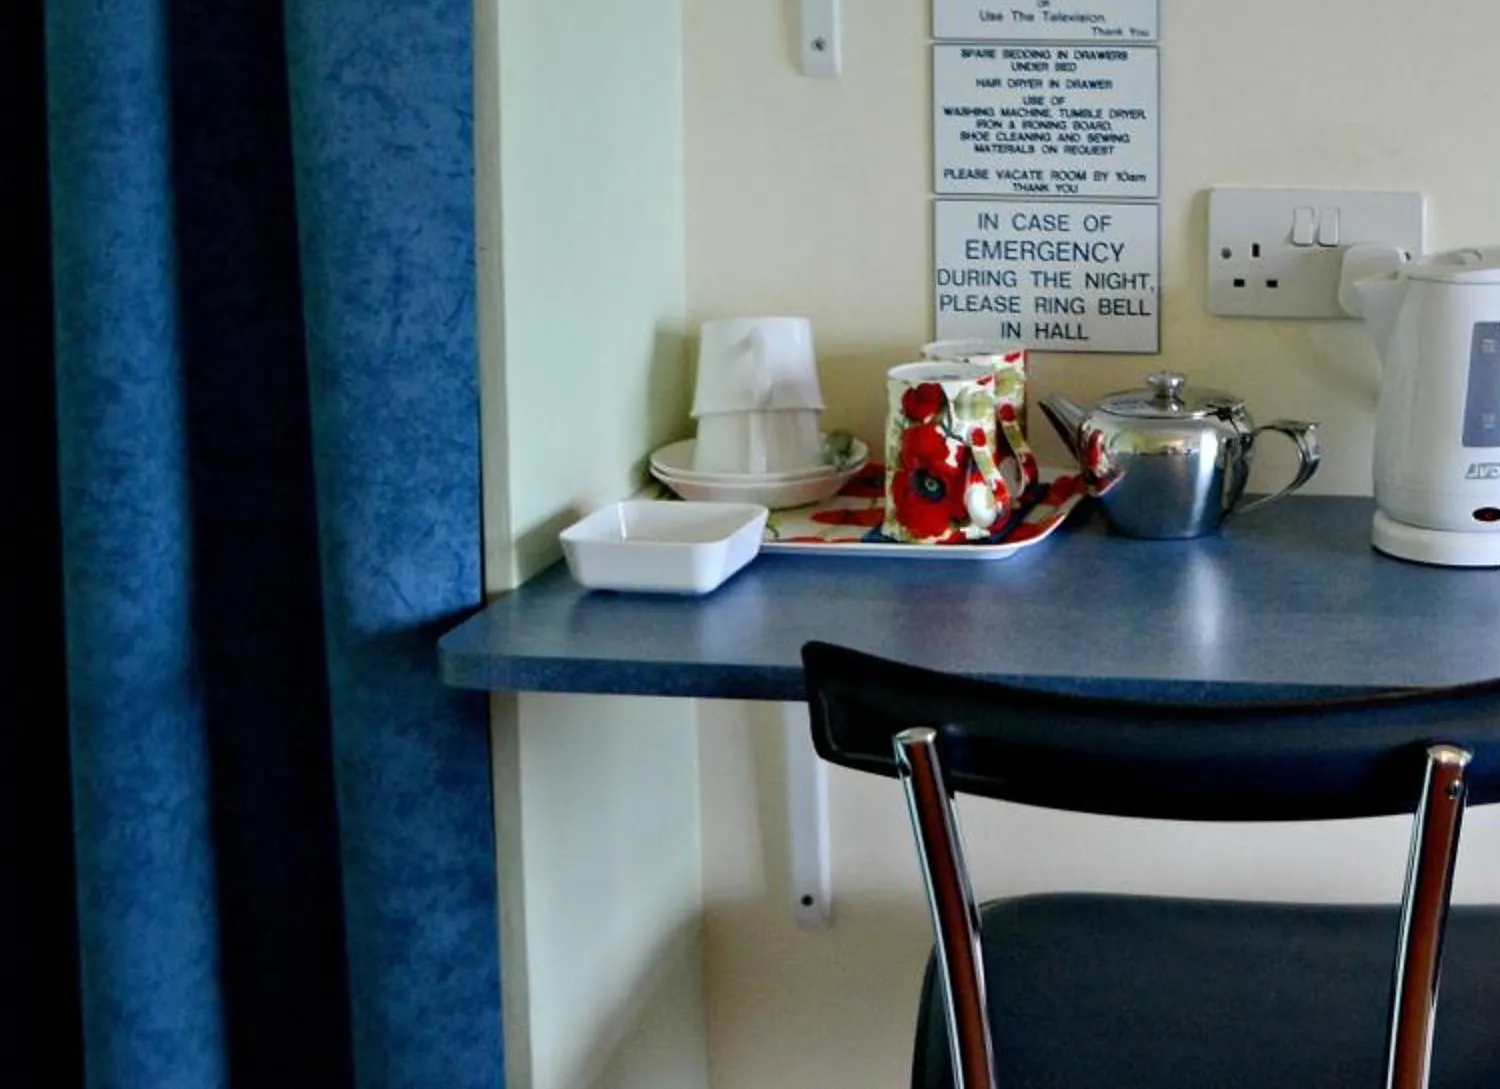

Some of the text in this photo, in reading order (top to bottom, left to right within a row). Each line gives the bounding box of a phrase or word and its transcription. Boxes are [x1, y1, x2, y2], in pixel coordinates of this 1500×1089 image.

[979, 10, 1003, 22] Use
[1011, 11, 1034, 22] The
[1092, 27, 1150, 37] Thank You
[960, 49, 1128, 60] SPARE BEDDING IN DRAWERS
[1011, 62, 1077, 72] UNDER BED
[975, 78, 1113, 90] HAIR DRYER IN DRAWER
[1022, 96, 1066, 106] USE OF
[943, 107, 995, 117] WASHING
[1059, 108, 1103, 118] TUMBLE
[976, 119, 1002, 129] IRON
[1022, 120, 1067, 130] IRONING
[959, 131, 1131, 143] SHOE CLEANING AND SEWING
[974, 143, 1115, 155] MATERIALS ON REQUEST
[943, 169, 1147, 182] PLEASE VACATE ROOM BY 10am
[1013, 182, 1078, 193] THANK YOU
[978, 213, 1113, 232] IN CASE OF
[965, 240, 1125, 263] EMERGENCY
[938, 268, 1155, 293] DURING THE NIGHT,
[940, 294, 1152, 316] PLEASE RING BELL
[1001, 322, 1089, 340] IN HALL
